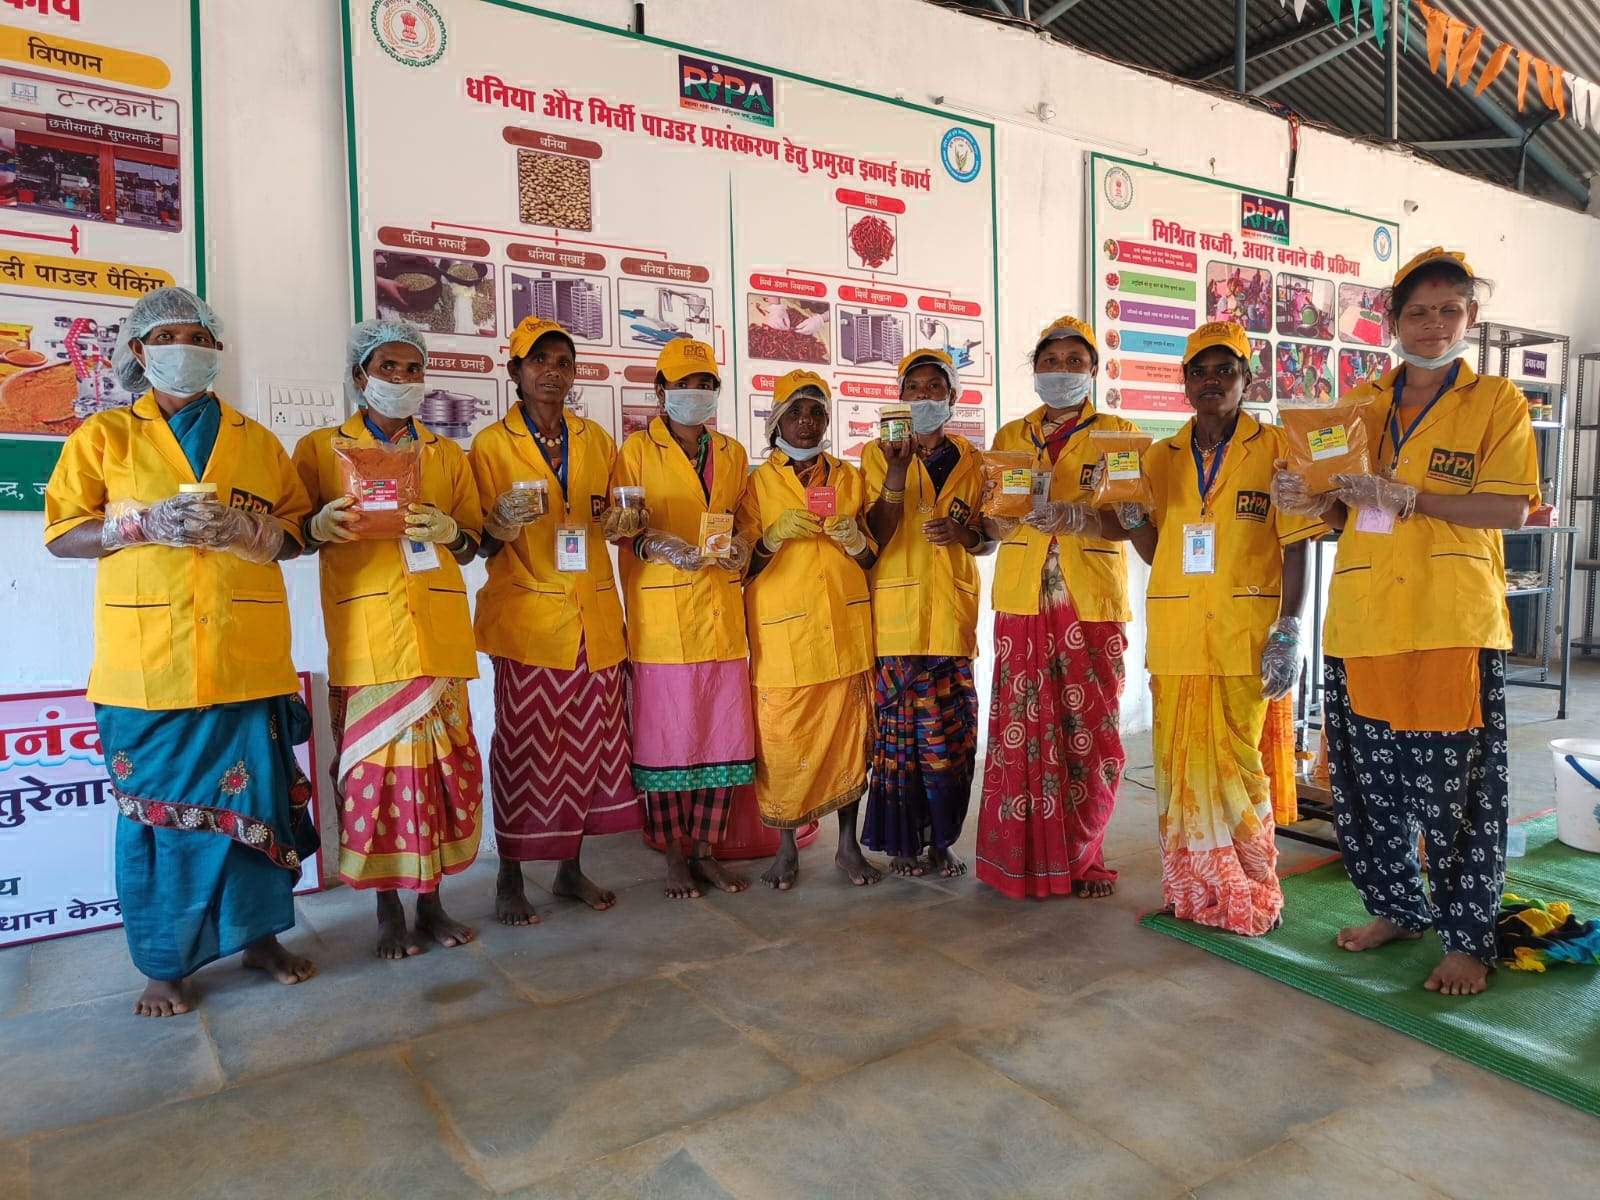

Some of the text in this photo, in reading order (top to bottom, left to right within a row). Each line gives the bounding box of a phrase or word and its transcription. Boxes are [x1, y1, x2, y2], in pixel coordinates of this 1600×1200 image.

[28, 36, 103, 73] विपणन
[108, 128, 161, 148] सुपरमार्केट
[466, 74, 931, 192] धनिया और मिर्ची पाउडर प्रसंस्करण हेतु प्रमुख इकाई कार्य
[539, 136, 568, 152] धनिया
[402, 231, 468, 252] धनिया सफाई
[1152, 217, 1196, 249] मिश्रित
[1242, 241, 1275, 263] अचार
[1278, 246, 1308, 269] बनाने
[1310, 250, 1326, 270] की
[1327, 253, 1361, 277] प्रक्रिया
[527, 248, 555, 263] धनिया
[35, 265, 98, 288] पाउडर
[640, 262, 665, 276] धनिया
